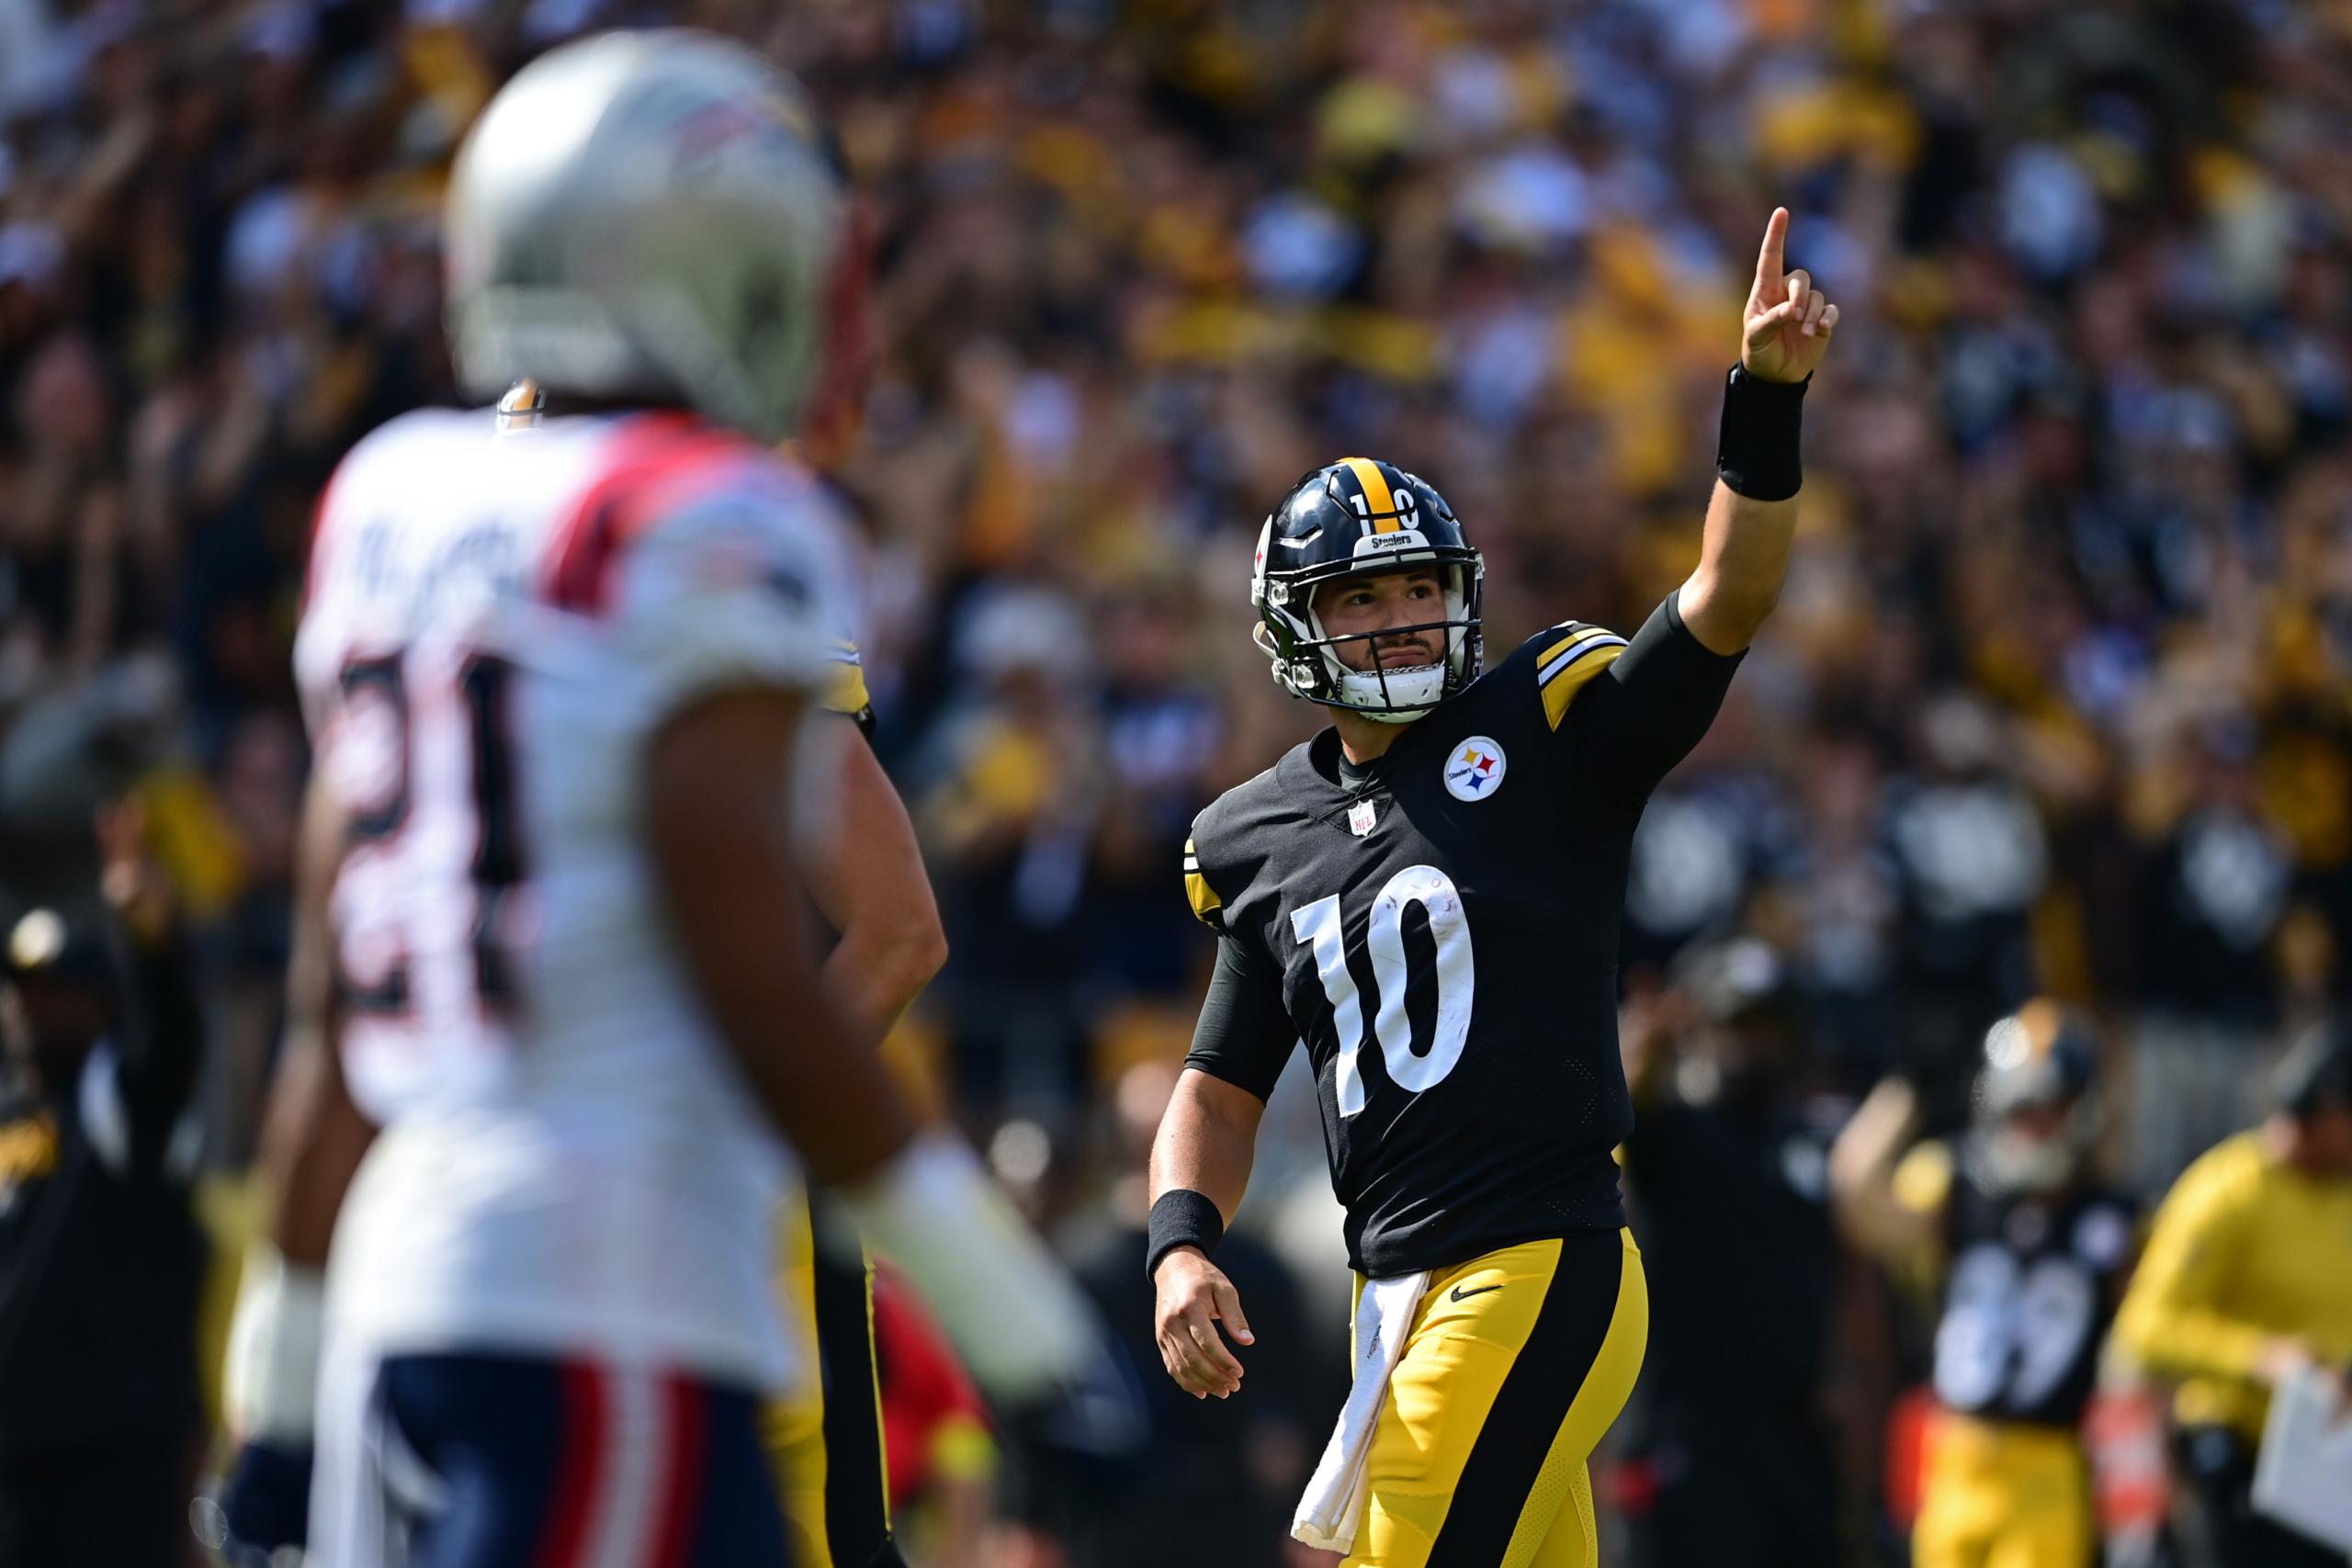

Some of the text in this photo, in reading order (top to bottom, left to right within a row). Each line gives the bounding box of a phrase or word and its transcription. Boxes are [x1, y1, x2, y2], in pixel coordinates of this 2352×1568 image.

[1350, 488, 1419, 536] 10
[1372, 534, 1412, 549] Steelers
[1354, 816, 1373, 831] NFL
[1290, 864, 1475, 1118] 10
